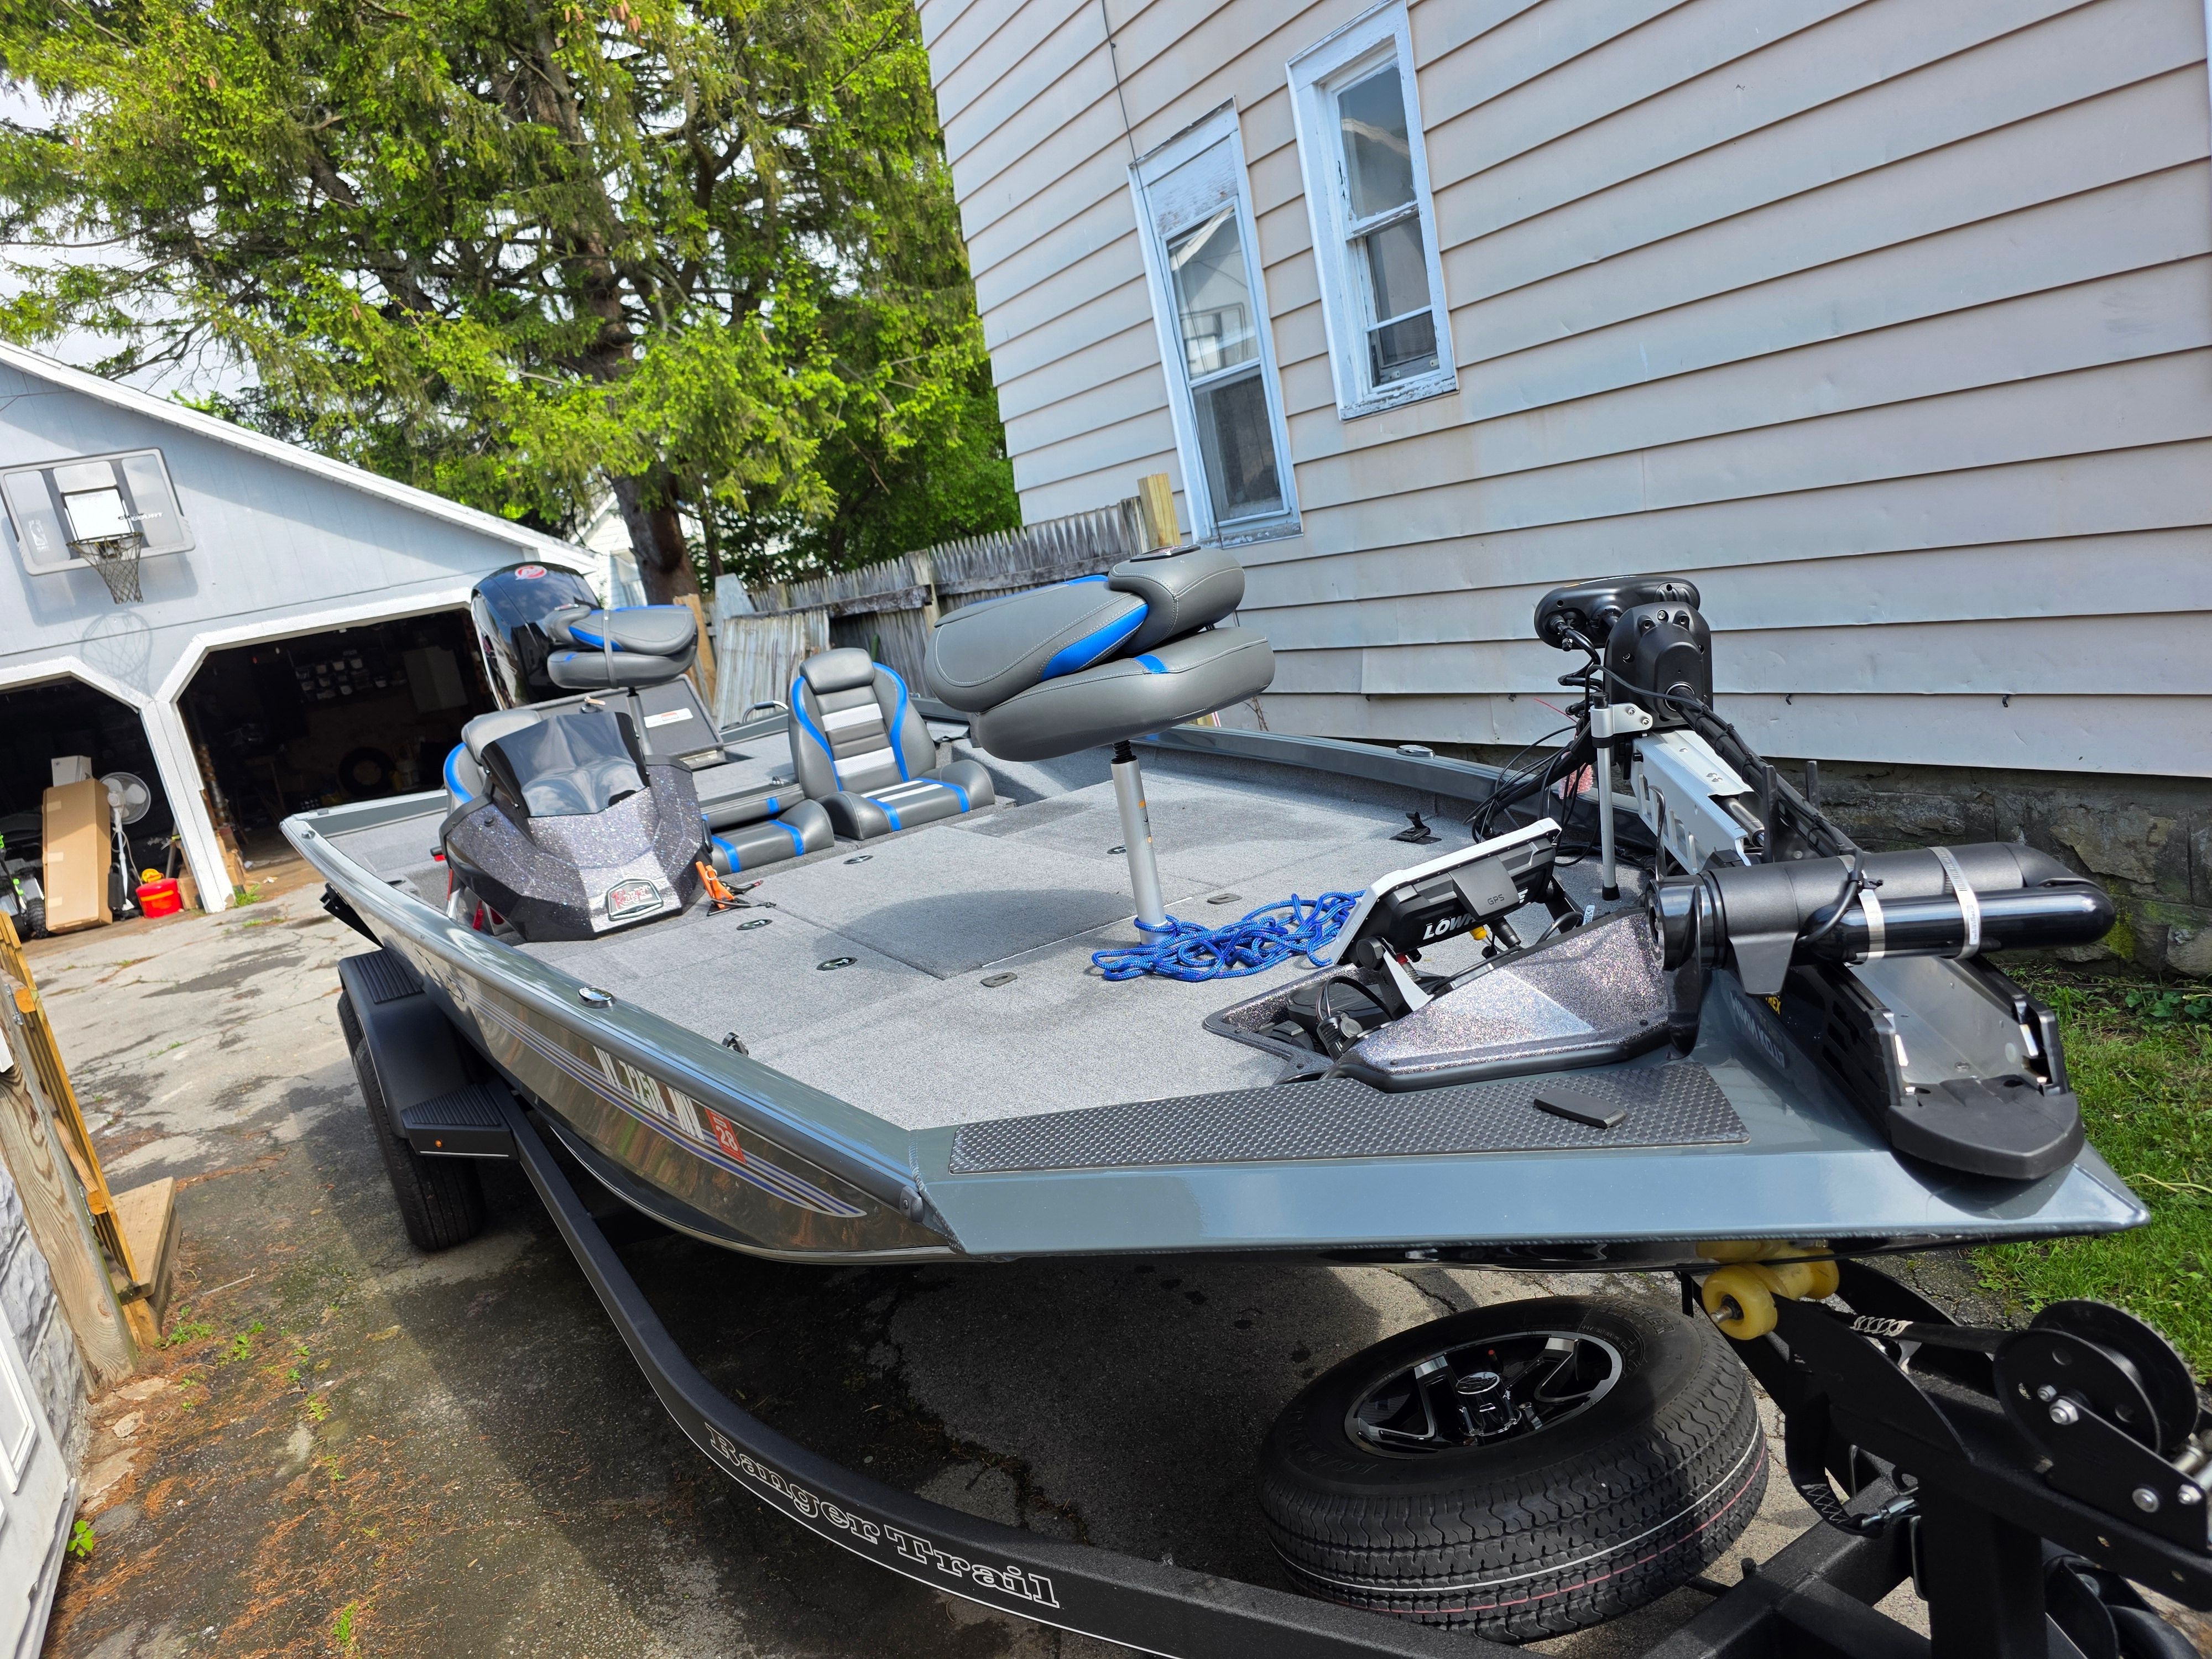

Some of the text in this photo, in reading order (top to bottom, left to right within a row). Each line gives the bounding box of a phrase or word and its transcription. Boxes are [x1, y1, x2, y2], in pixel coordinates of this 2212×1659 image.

[1487, 894, 1505, 906] GPS
[618, 1060, 669, 1120] 7258
[716, 1125, 738, 1152] 28
[705, 1422, 1060, 1609] Ranger Trail
